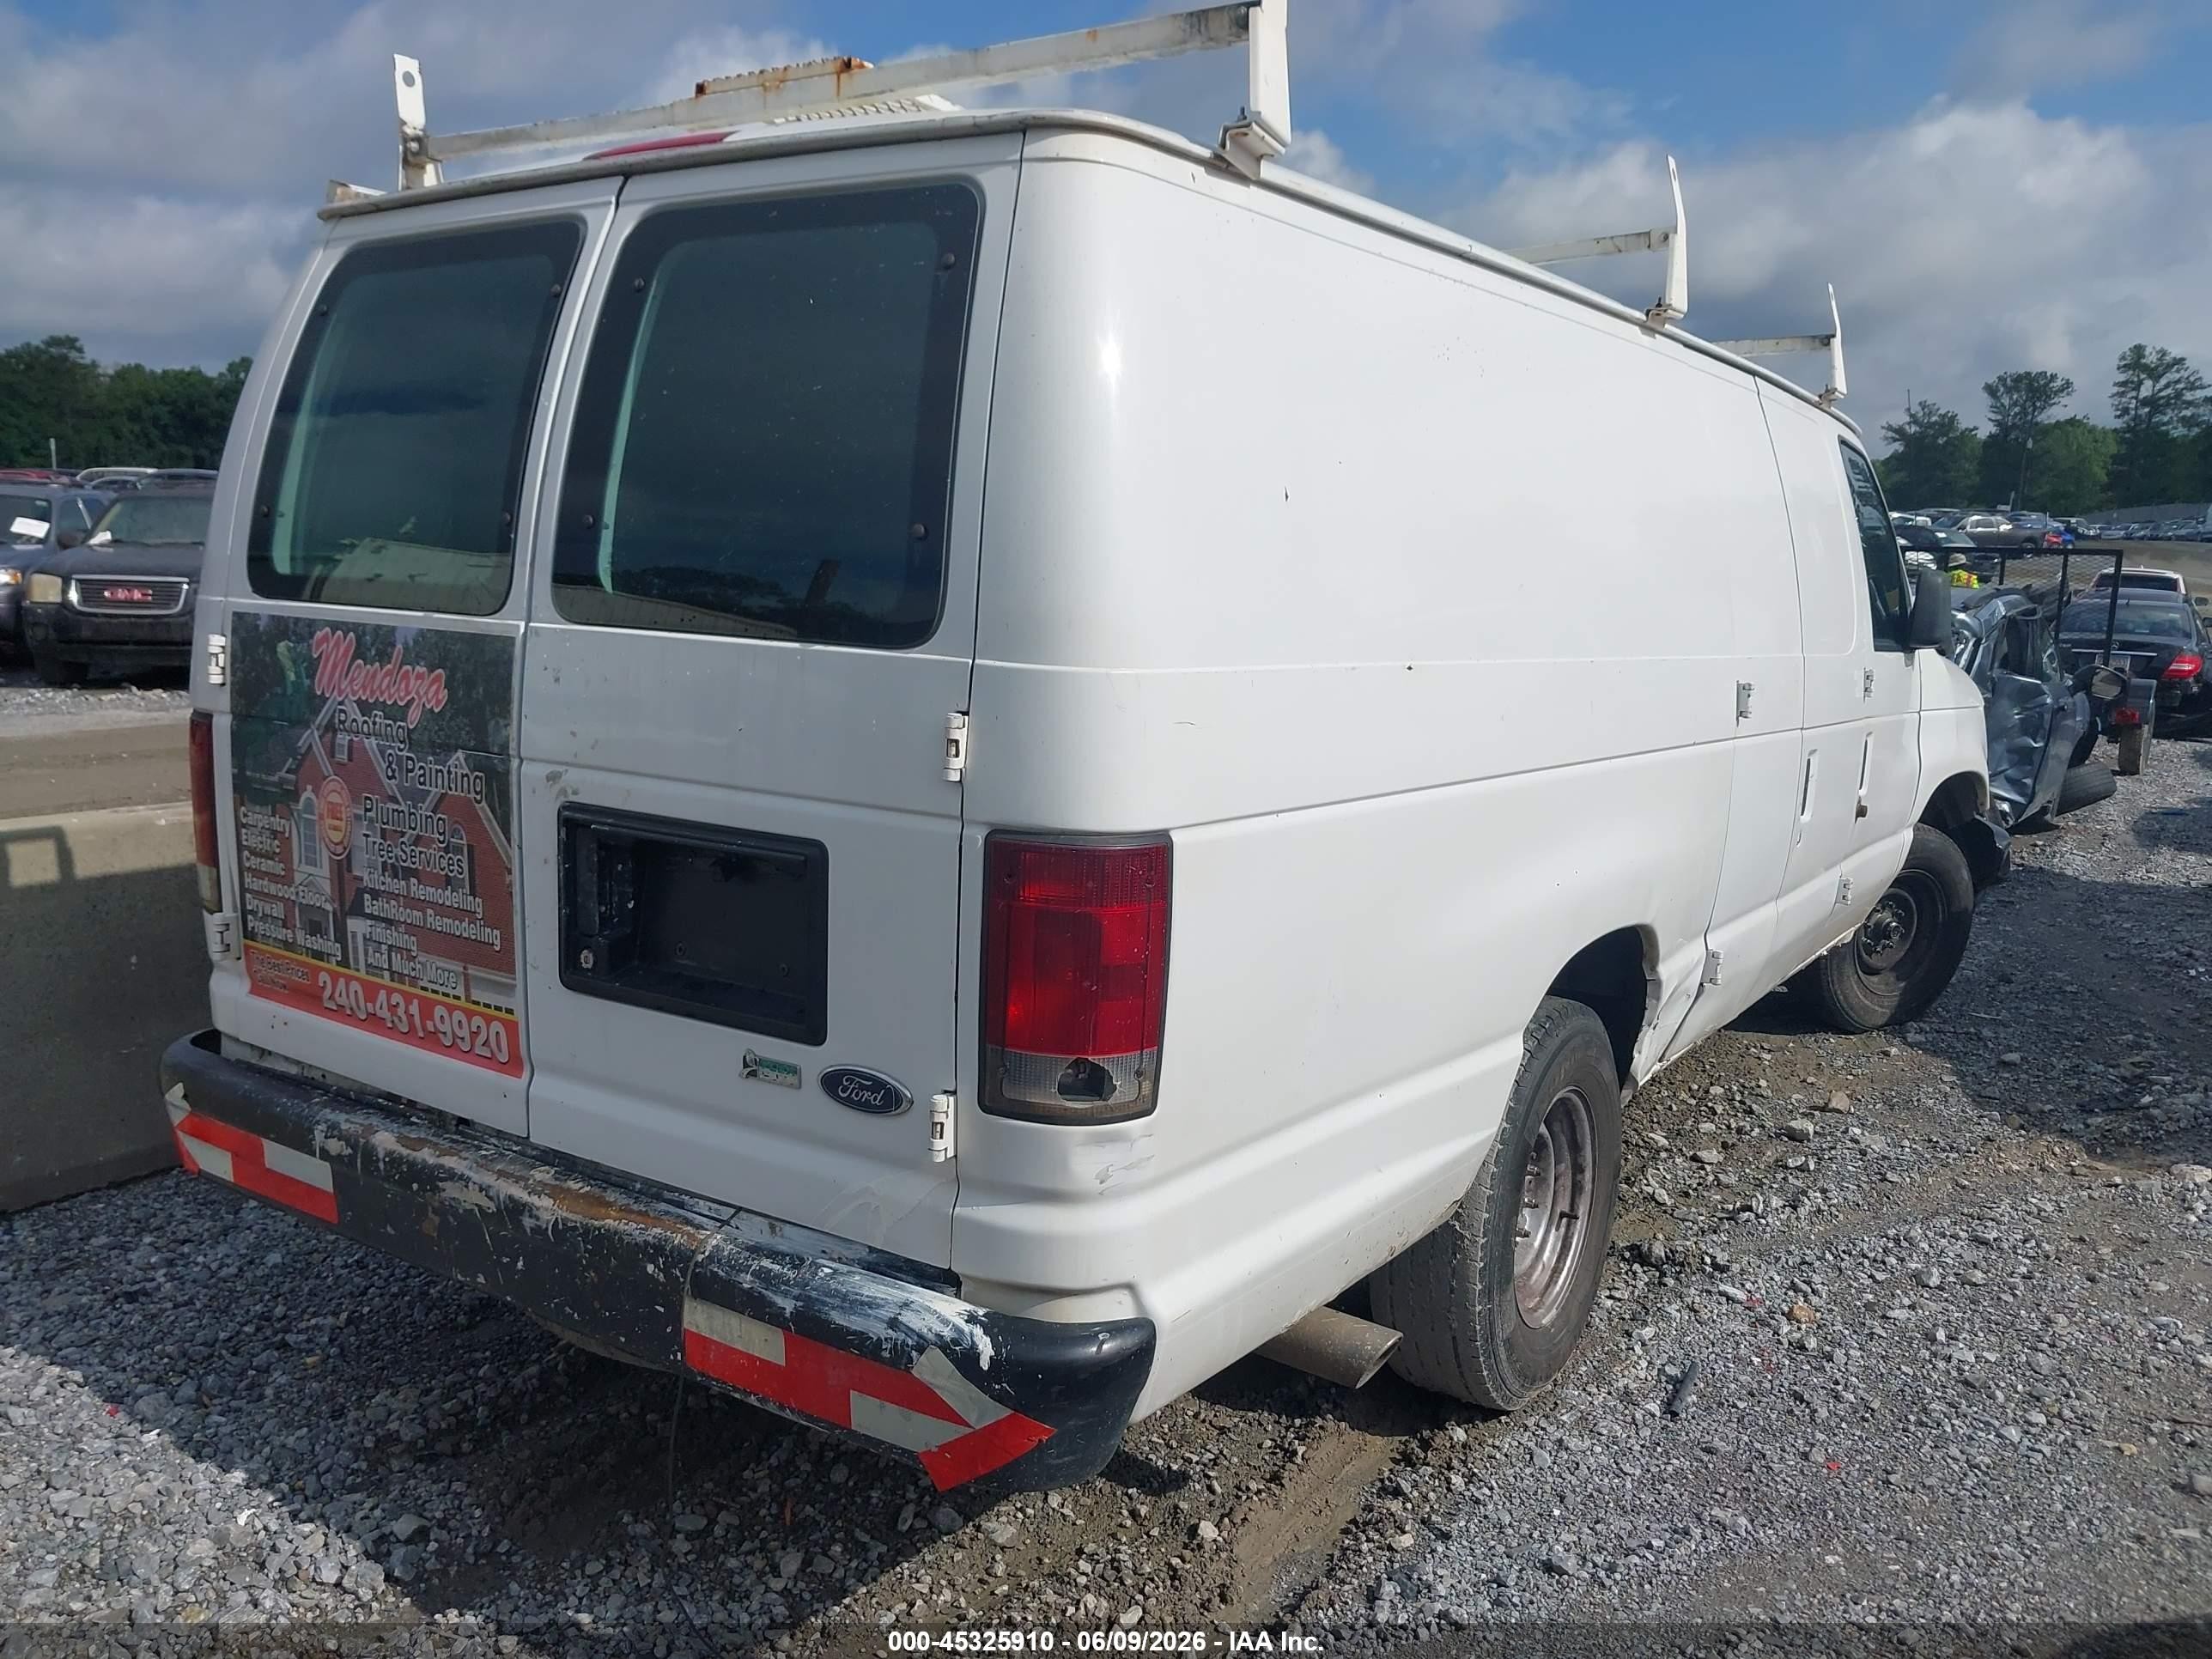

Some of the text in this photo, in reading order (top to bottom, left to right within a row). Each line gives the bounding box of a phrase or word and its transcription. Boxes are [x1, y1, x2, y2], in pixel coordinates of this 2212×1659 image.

[313, 627, 447, 728] Mendoza
[336, 706, 409, 752] Roofing
[386, 752, 485, 805] & Painting
[240, 806, 291, 837] Carpentry
[362, 794, 447, 847] Plumbing
[243, 850, 285, 875] Ceramic
[362, 832, 465, 878] Tree Services
[245, 872, 296, 900] Hardwood
[246, 893, 284, 919] Drywall
[363, 867, 483, 919] Kitchen Remodeling
[247, 915, 342, 962] Pressure Washing
[363, 894, 501, 951] BathRoom Remodeling
[366, 920, 417, 957] Finishing
[368, 945, 458, 989] And Much More
[319, 971, 509, 1064] 240-431-9920
[838, 1075, 884, 1107] Ford
